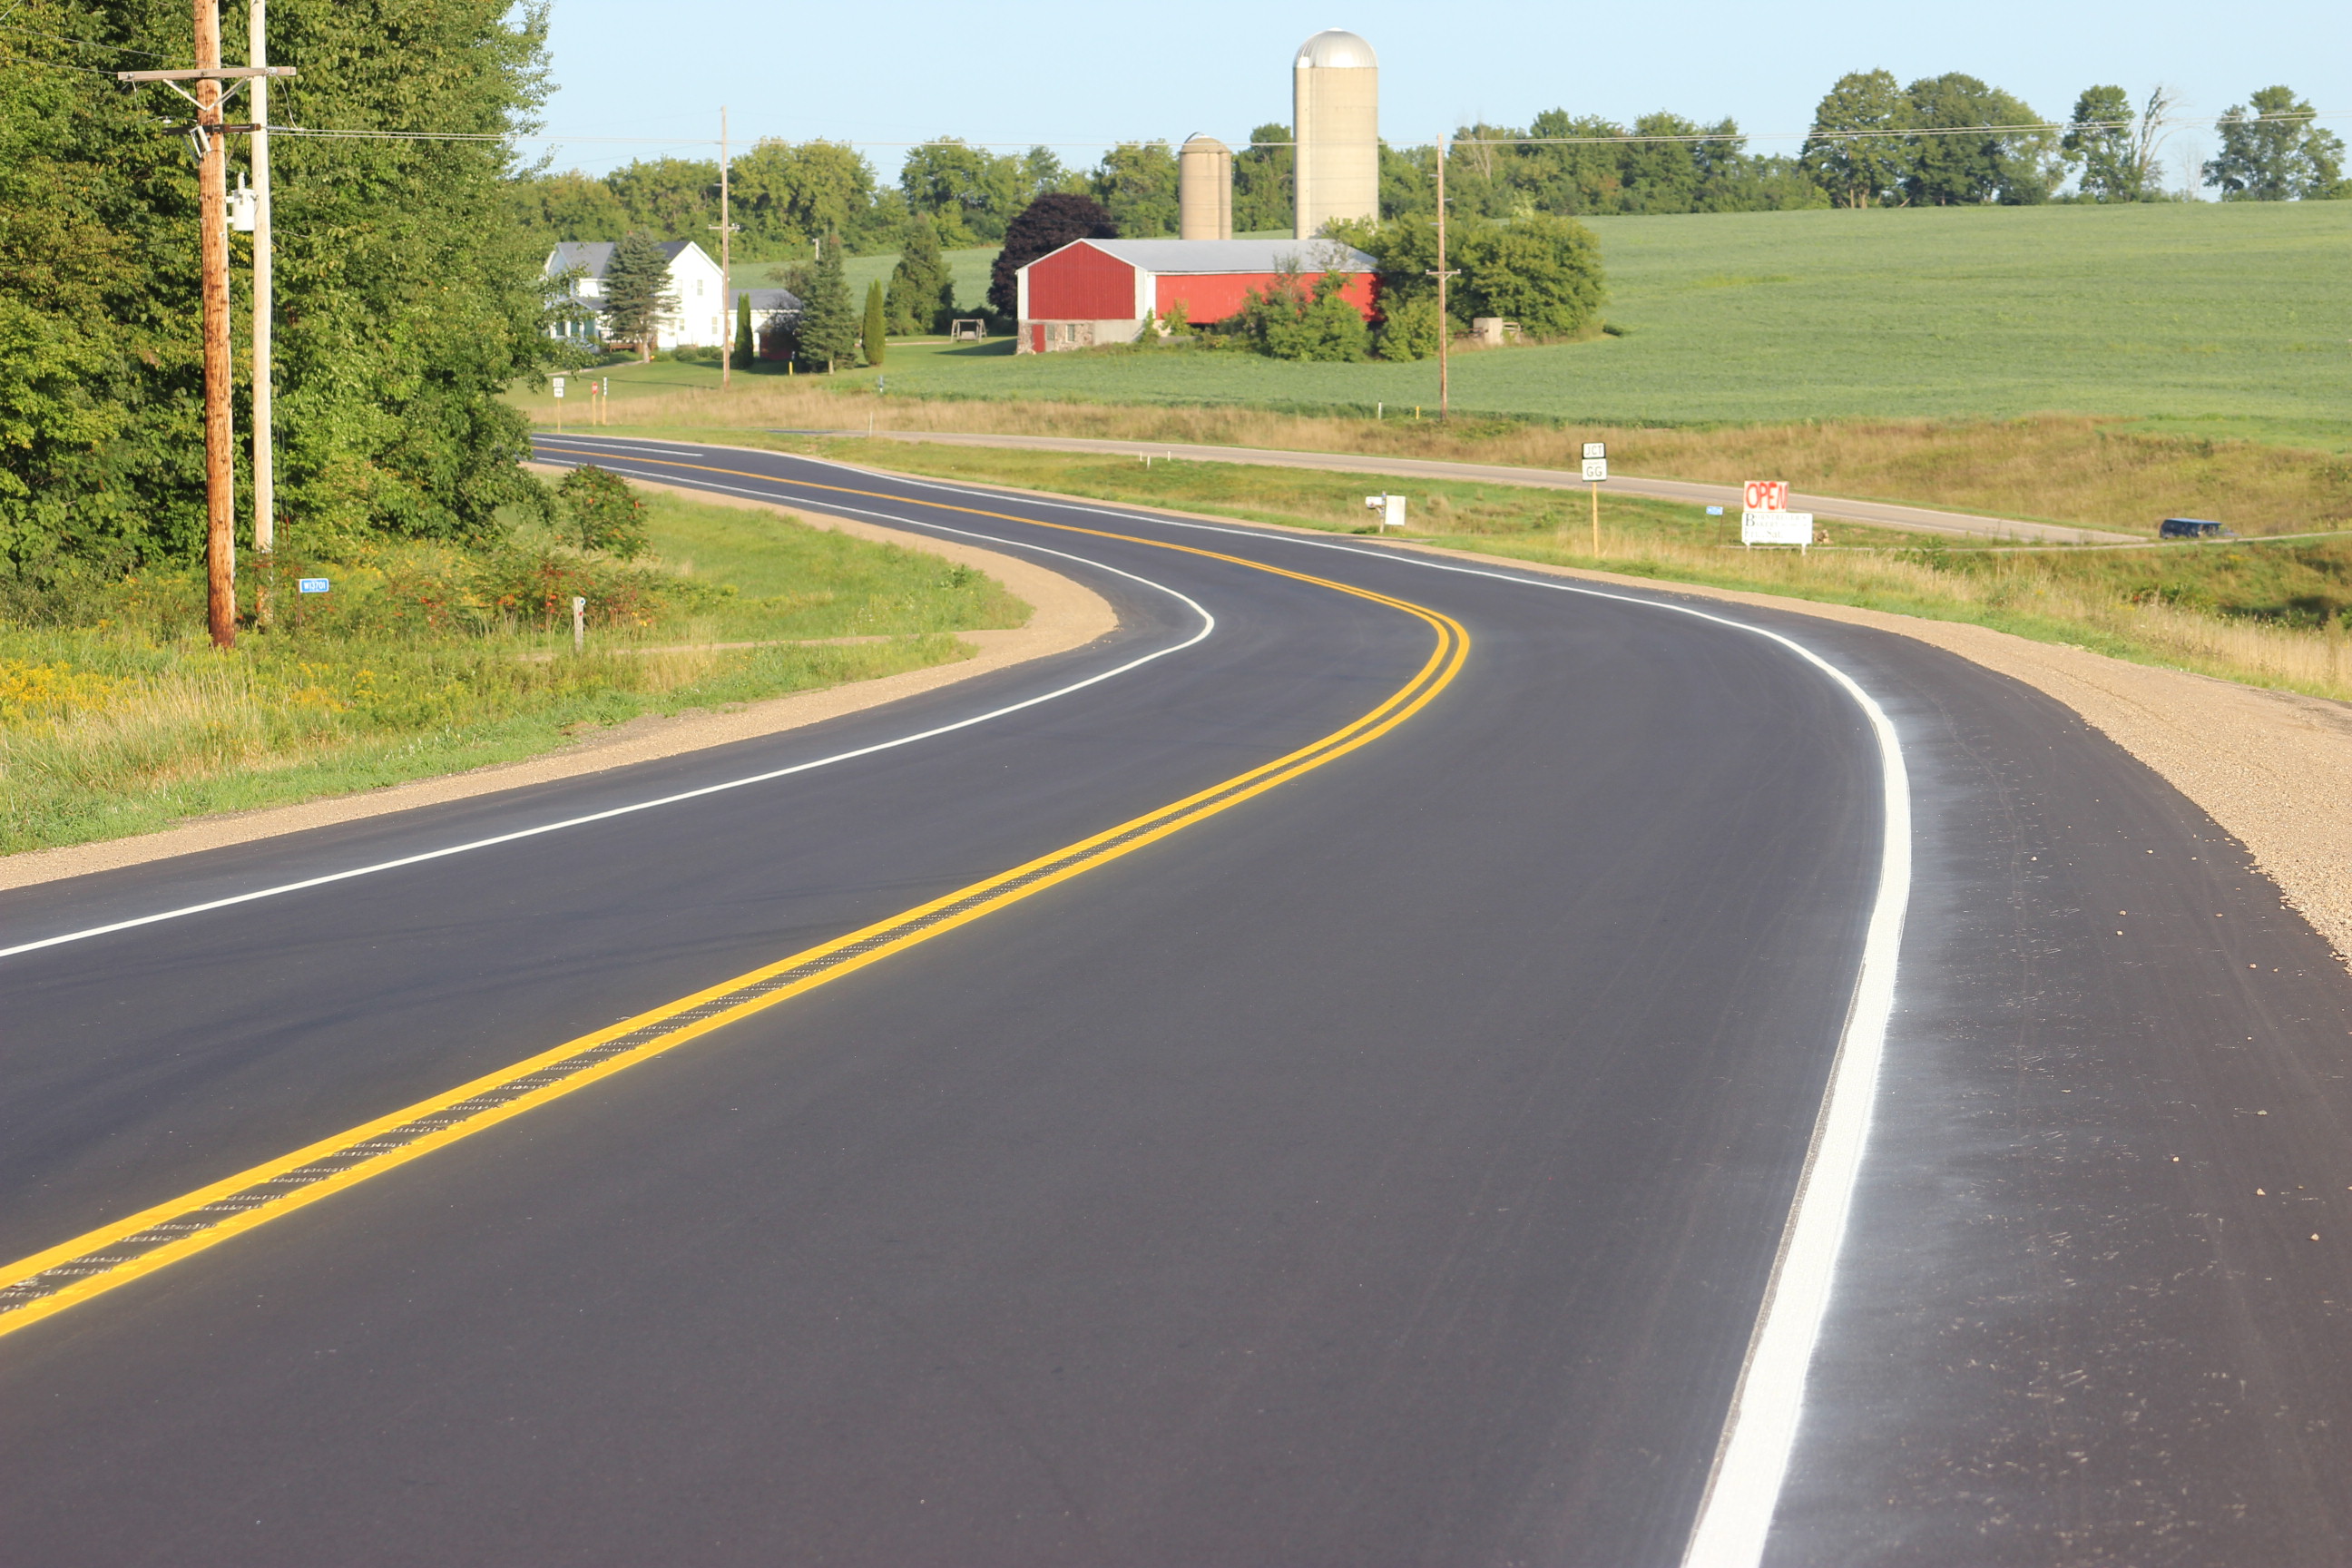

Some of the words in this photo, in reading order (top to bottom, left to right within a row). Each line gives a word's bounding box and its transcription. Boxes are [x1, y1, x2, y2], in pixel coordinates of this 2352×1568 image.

[1585, 445, 1602, 456] JCT
[1586, 466, 1602, 477] GG
[1746, 481, 1788, 510] OPEN
[303, 581, 326, 590] W13701
